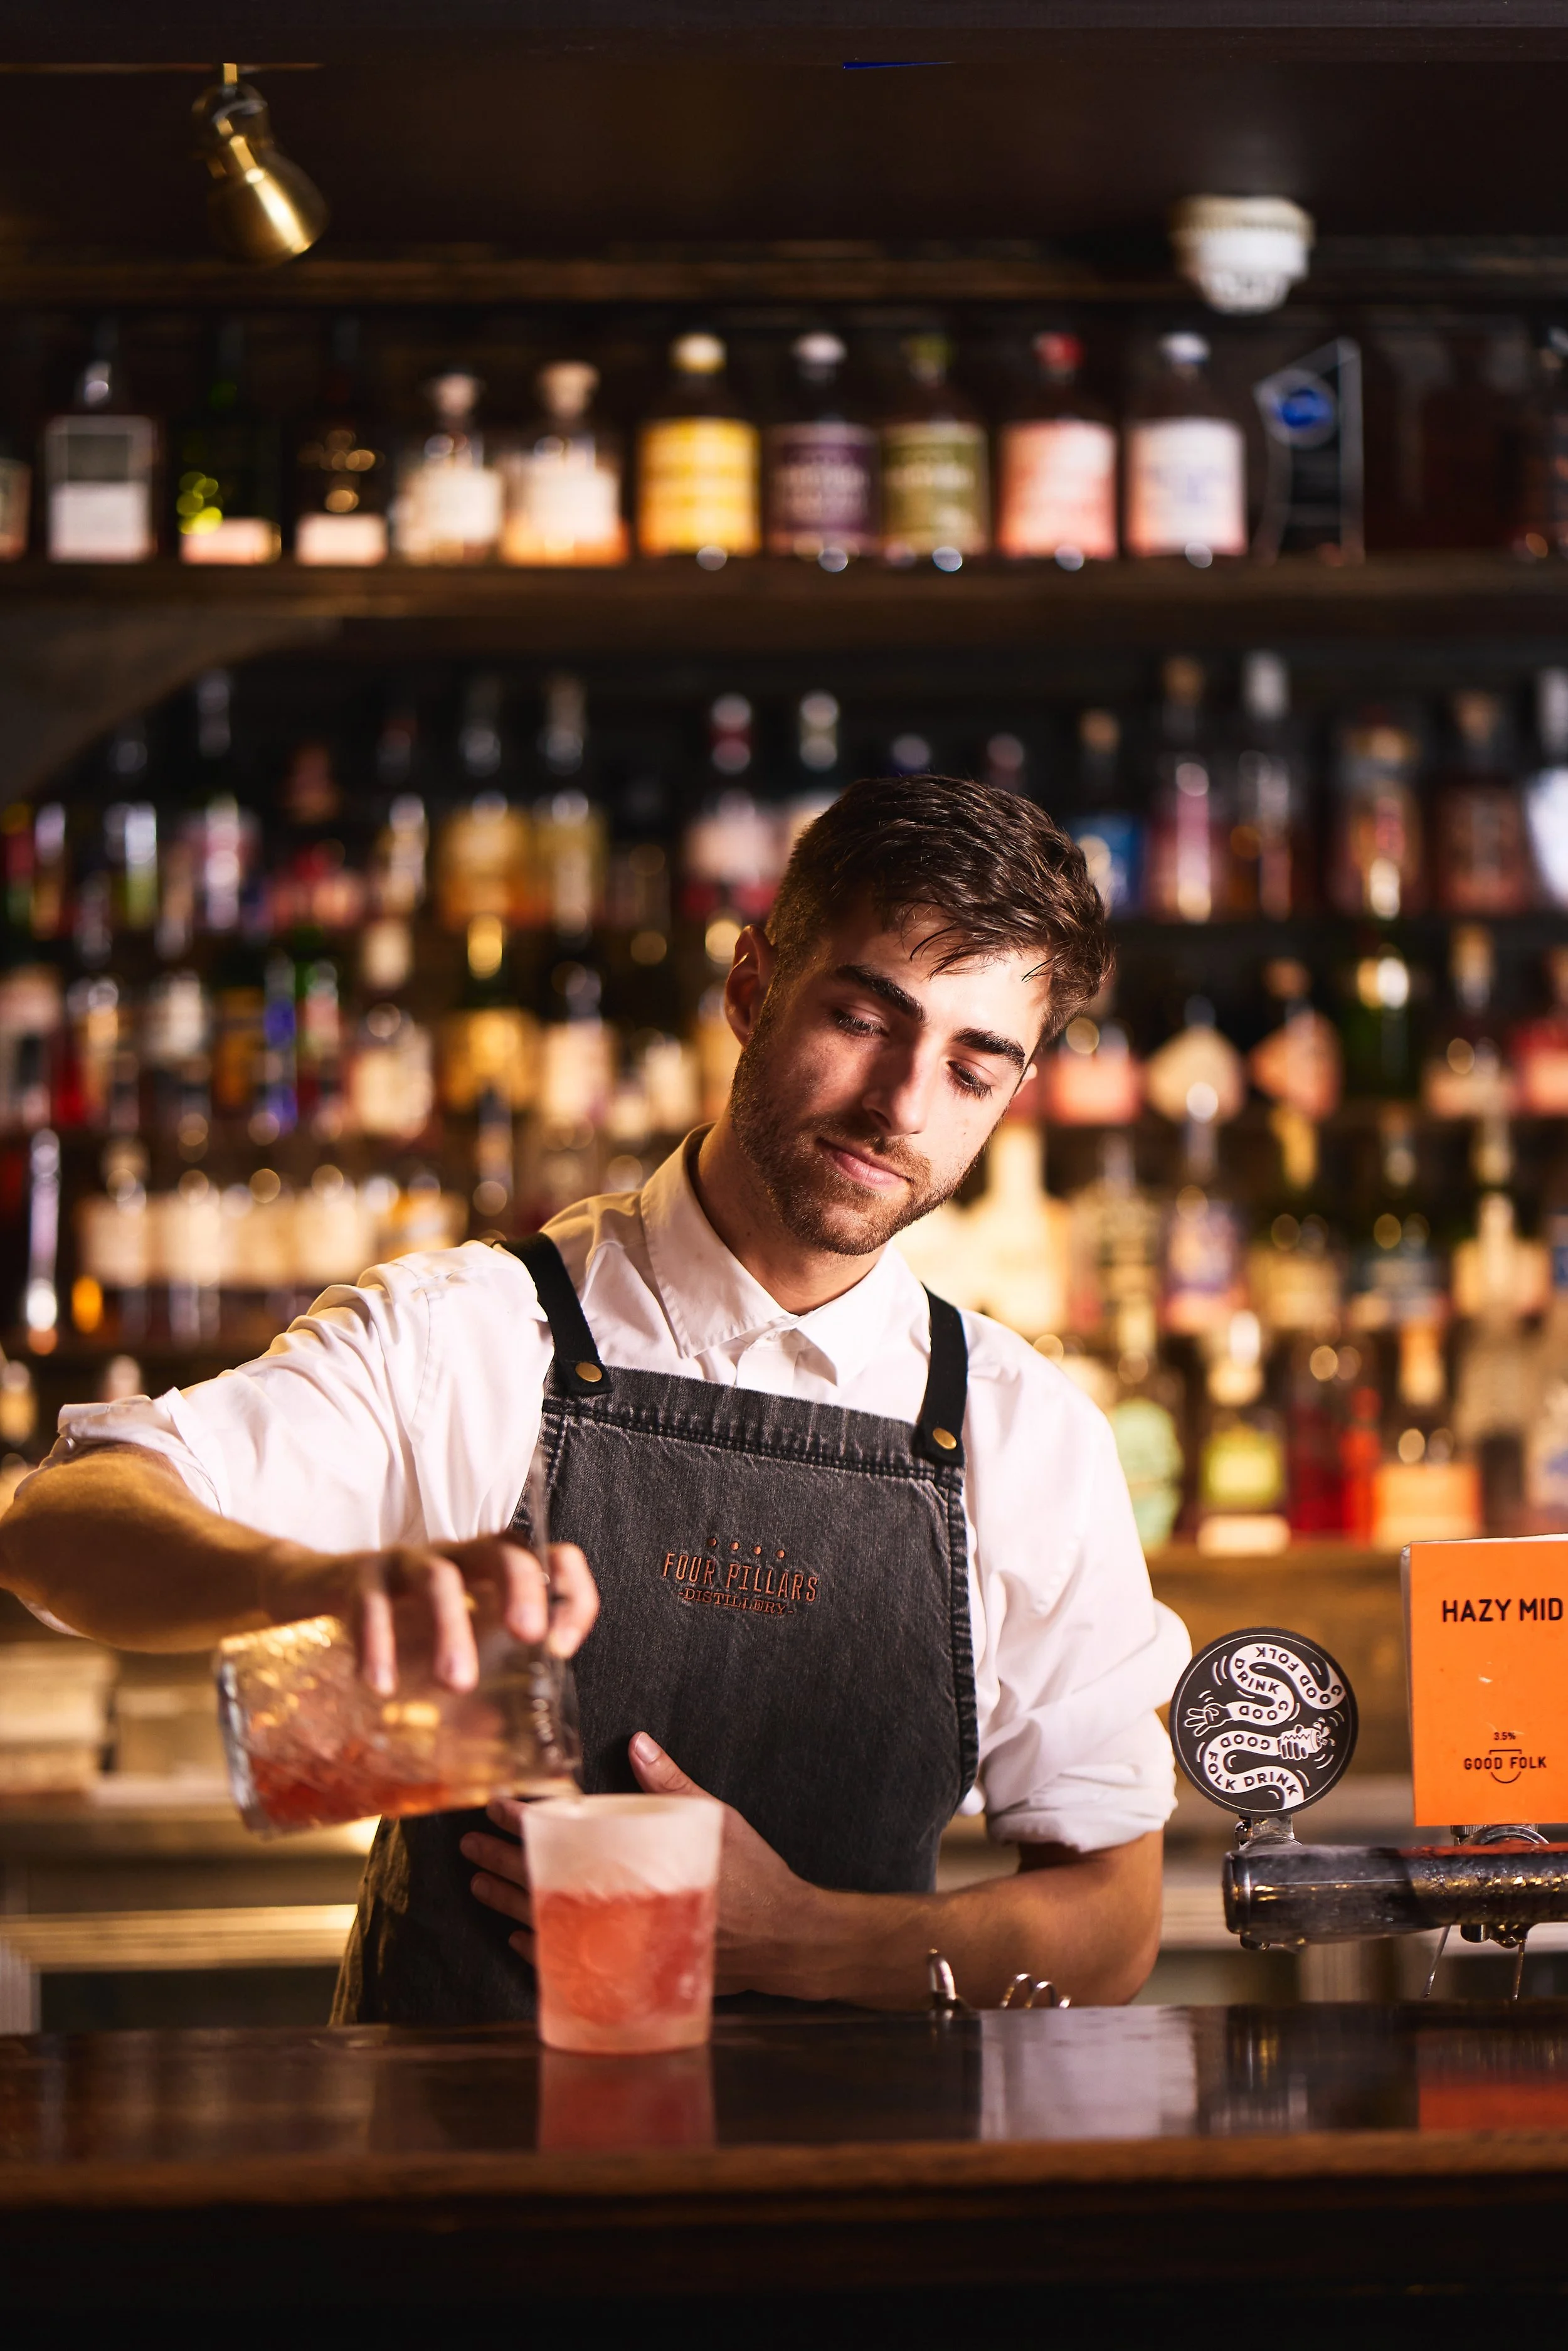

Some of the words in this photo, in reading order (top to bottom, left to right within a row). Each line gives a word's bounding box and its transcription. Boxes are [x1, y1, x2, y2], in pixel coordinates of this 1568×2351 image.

[662, 1552, 717, 1586] FOUR
[725, 1562, 818, 1602] PILLARS
[1442, 1599, 1512, 1623] HAZY
[1519, 1597, 1564, 1621] MID
[1255, 1646, 1300, 1672] FOLK
[1234, 1657, 1281, 1695] DRINK
[1300, 1674, 1343, 1705] GOOD
[1239, 1700, 1289, 1721] GOOD
[1220, 1734, 1271, 1751] GOOD
[1493, 1731, 1517, 1741] 3.5%
[1207, 1751, 1237, 1791] FOLK
[1463, 1757, 1503, 1770] GOOD
[1510, 1756, 1547, 1769] FOLK
[1243, 1771, 1300, 1797] DRINK
